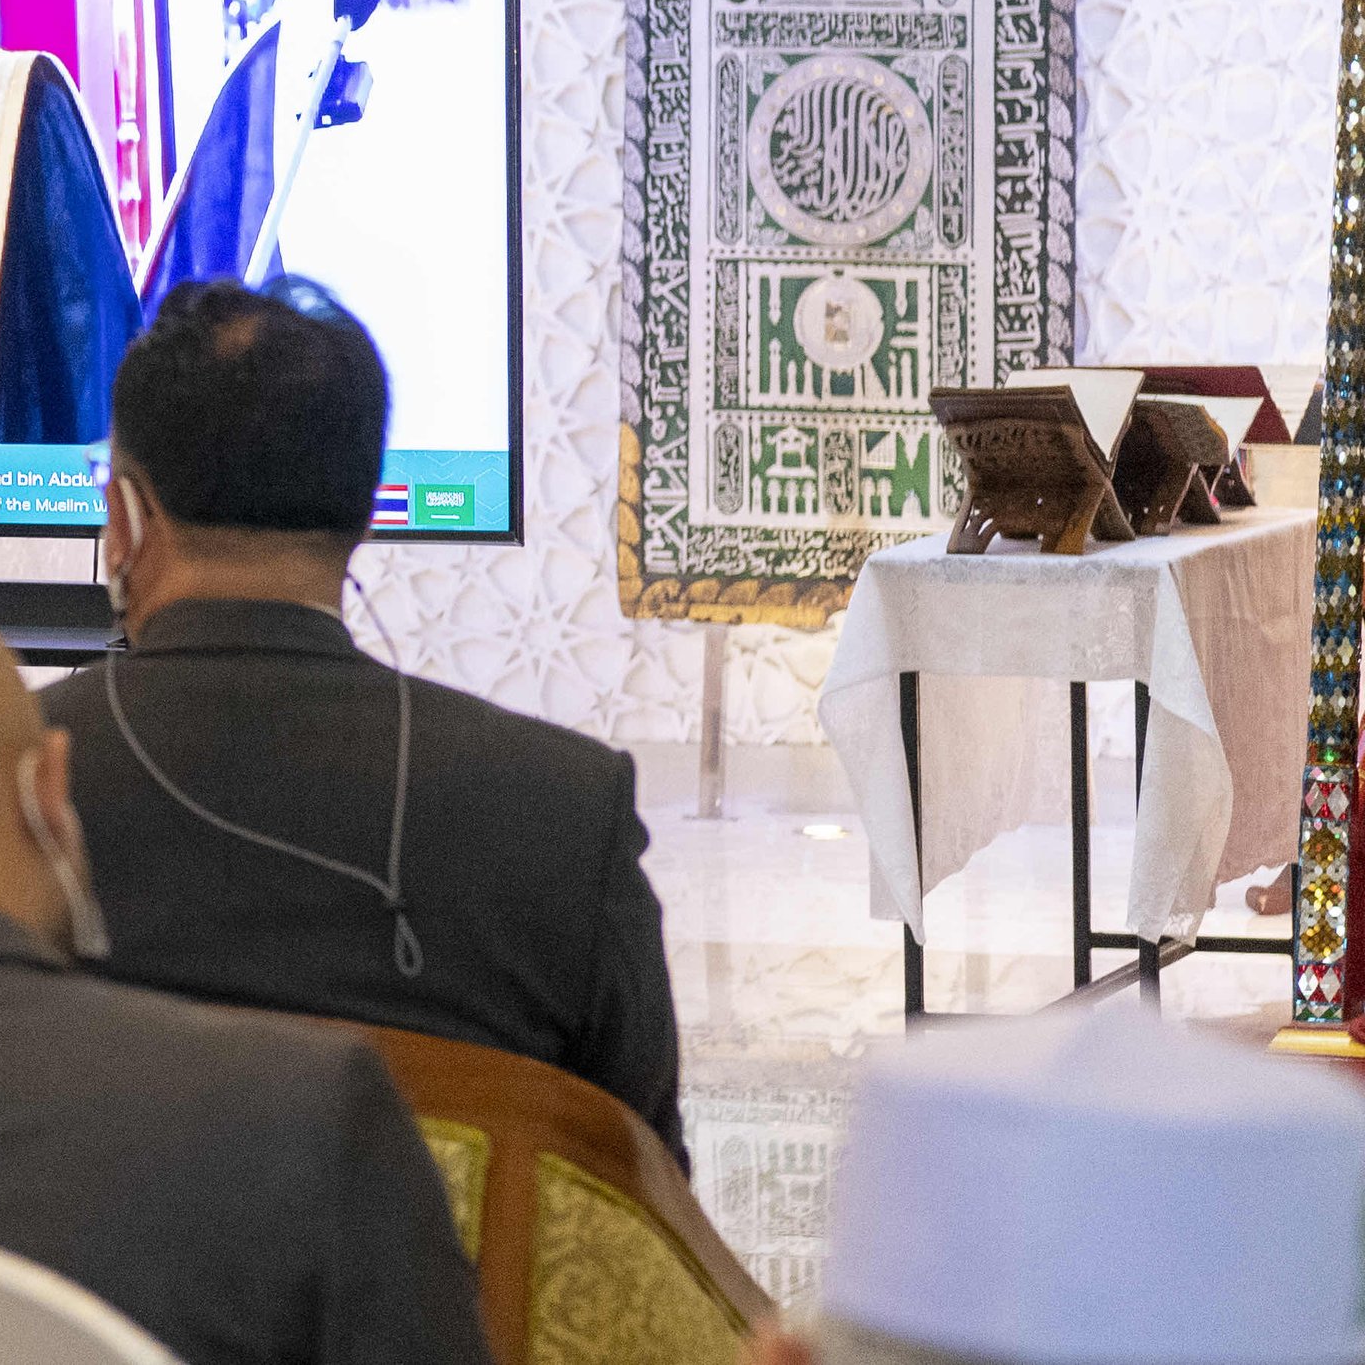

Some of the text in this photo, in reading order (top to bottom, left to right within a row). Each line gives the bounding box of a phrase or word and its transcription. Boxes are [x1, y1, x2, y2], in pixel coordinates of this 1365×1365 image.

[17, 471, 44, 486] bin
[6, 497, 31, 512] the
[36, 498, 89, 512] Muslim
